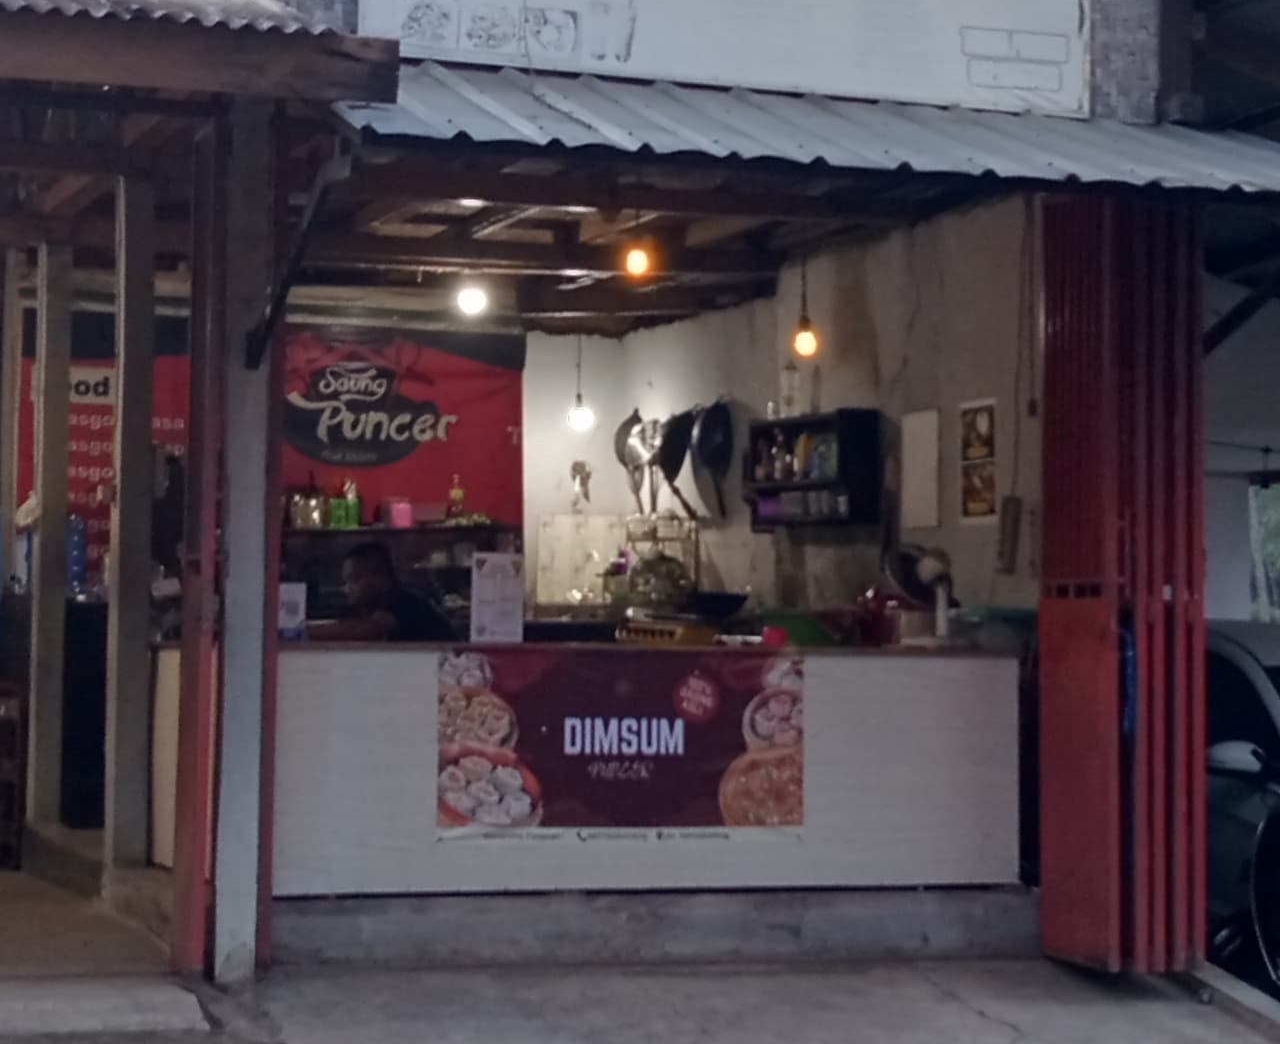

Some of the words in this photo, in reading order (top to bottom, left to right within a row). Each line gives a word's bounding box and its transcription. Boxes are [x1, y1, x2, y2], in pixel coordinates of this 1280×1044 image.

[72, 376, 110, 397] od
[319, 361, 387, 401] Saung
[287, 391, 458, 443] Puncer
[563, 717, 684, 755] DIMSUM
